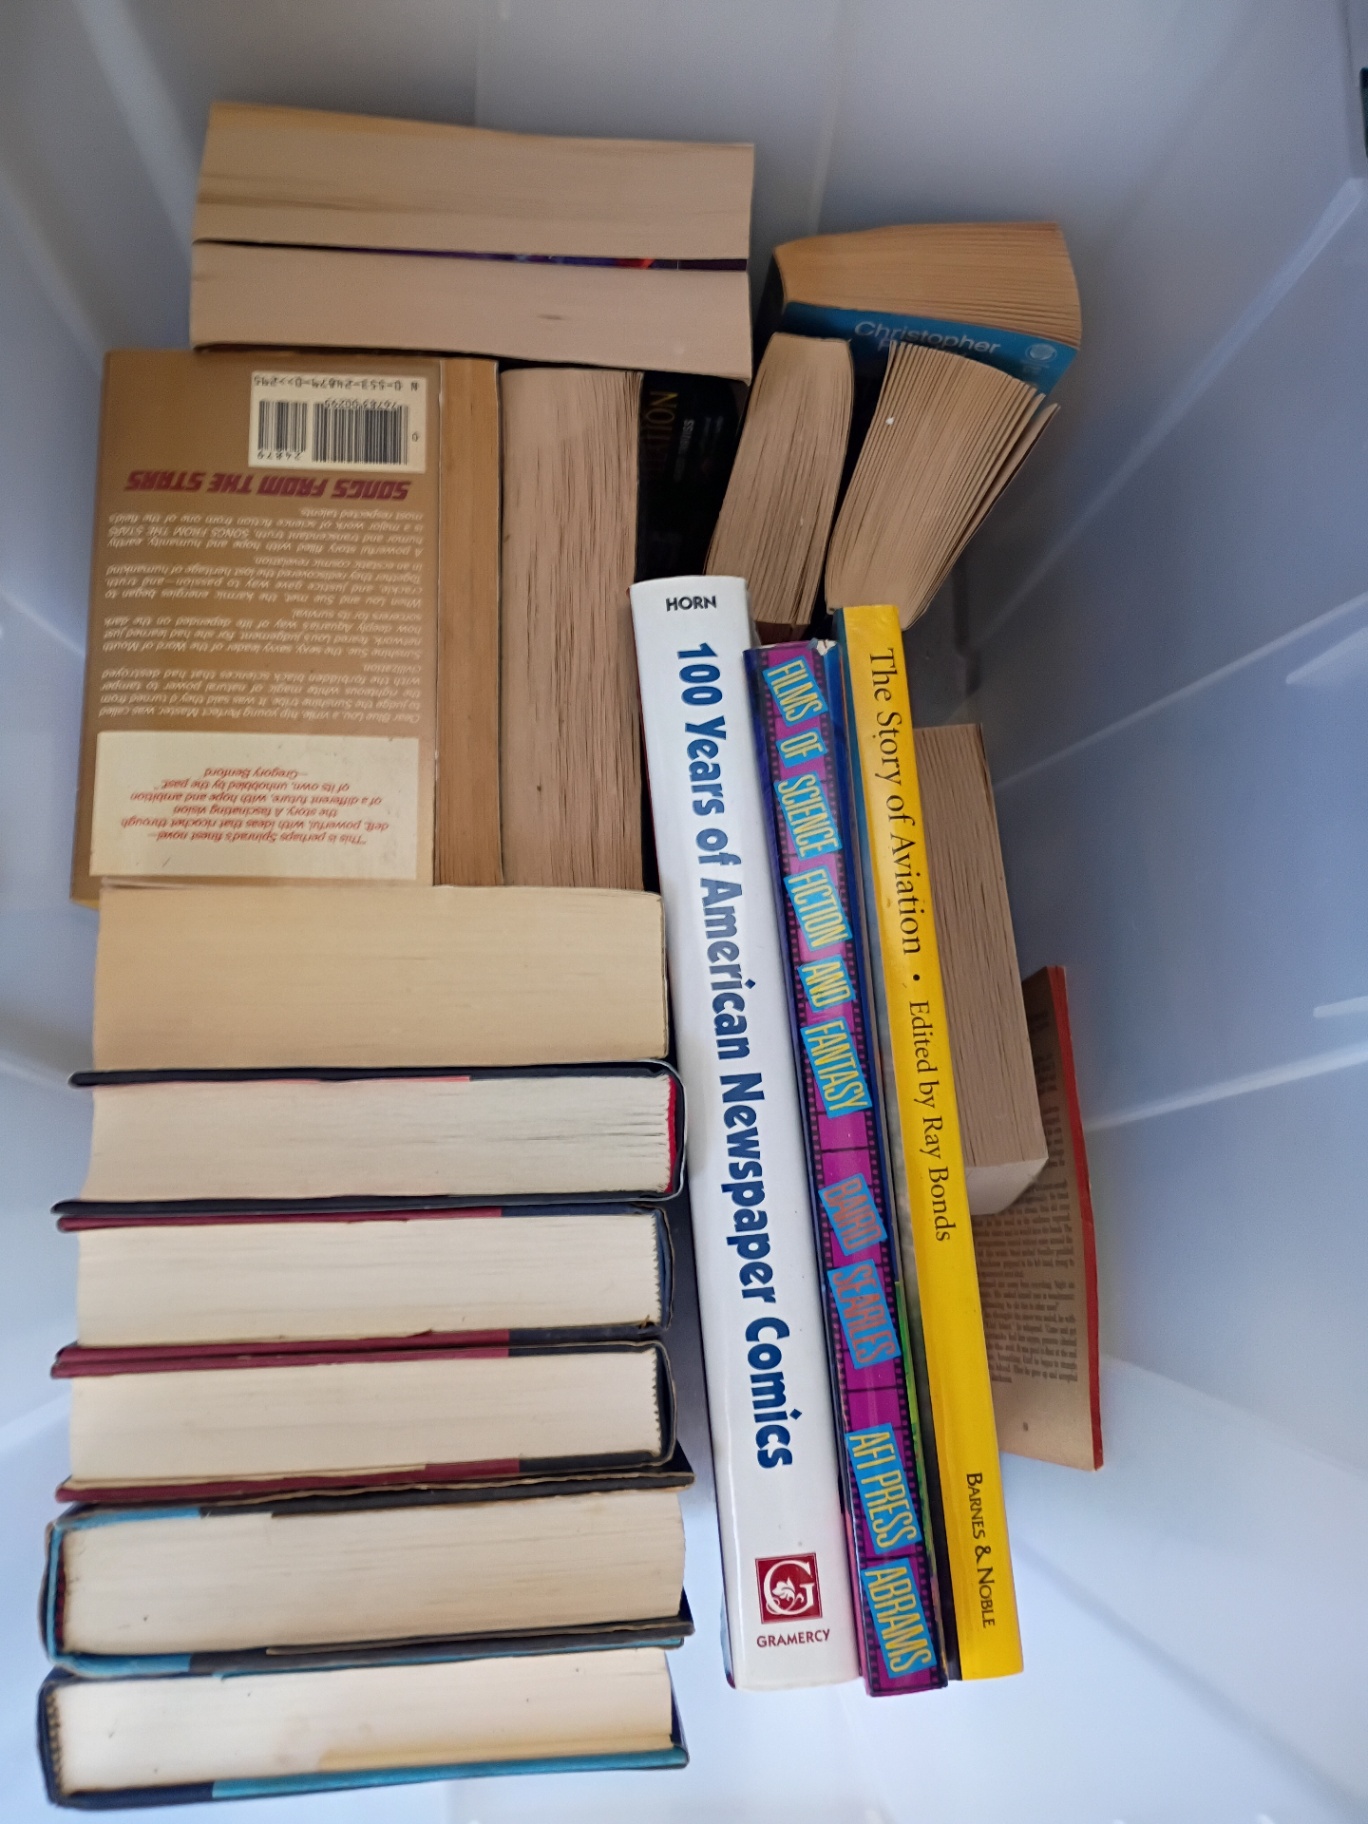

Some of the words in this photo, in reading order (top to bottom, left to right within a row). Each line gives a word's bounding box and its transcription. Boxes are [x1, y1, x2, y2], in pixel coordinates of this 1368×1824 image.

[855, 321, 1001, 354] Christopher
[124, 470, 203, 492] STARS
[210, 475, 252, 495] THE
[257, 477, 327, 498] FROM
[333, 480, 411, 500] SONGS
[666, 595, 717, 611] HORN
[677, 642, 723, 706] 100
[766, 659, 823, 722] FILMS
[870, 647, 898, 702] The
[685, 715, 727, 816] Years
[779, 731, 824, 759] OF
[875, 711, 903, 786] Story
[777, 774, 838, 857] SCIENCE
[886, 794, 915, 826] of
[696, 827, 742, 866] of
[787, 868, 848, 948] FICTION
[890, 834, 924, 955] Aviation
[700, 877, 756, 1060] American
[802, 961, 850, 1008] AND
[805, 1020, 868, 1111] FANTASY
[910, 1001, 938, 1073] Edited
[914, 1080, 937, 1109] by
[920, 1116, 943, 1159] Ray
[720, 1072, 776, 1304] Newspaper
[823, 1178, 882, 1250] BAIRD
[929, 1167, 956, 1242] Bonds
[831, 1265, 895, 1363] SEARLES
[745, 1317, 802, 1469] Comics
[849, 1431, 897, 1470] AFI
[861, 1469, 917, 1554] PRESS
[967, 1472, 985, 1540] BARNES
[976, 1545, 991, 1563] &
[864, 1566, 932, 1673] ABRAMS
[977, 1567, 996, 1629] NOBLE
[756, 1629, 830, 1648] GRAMERCY
